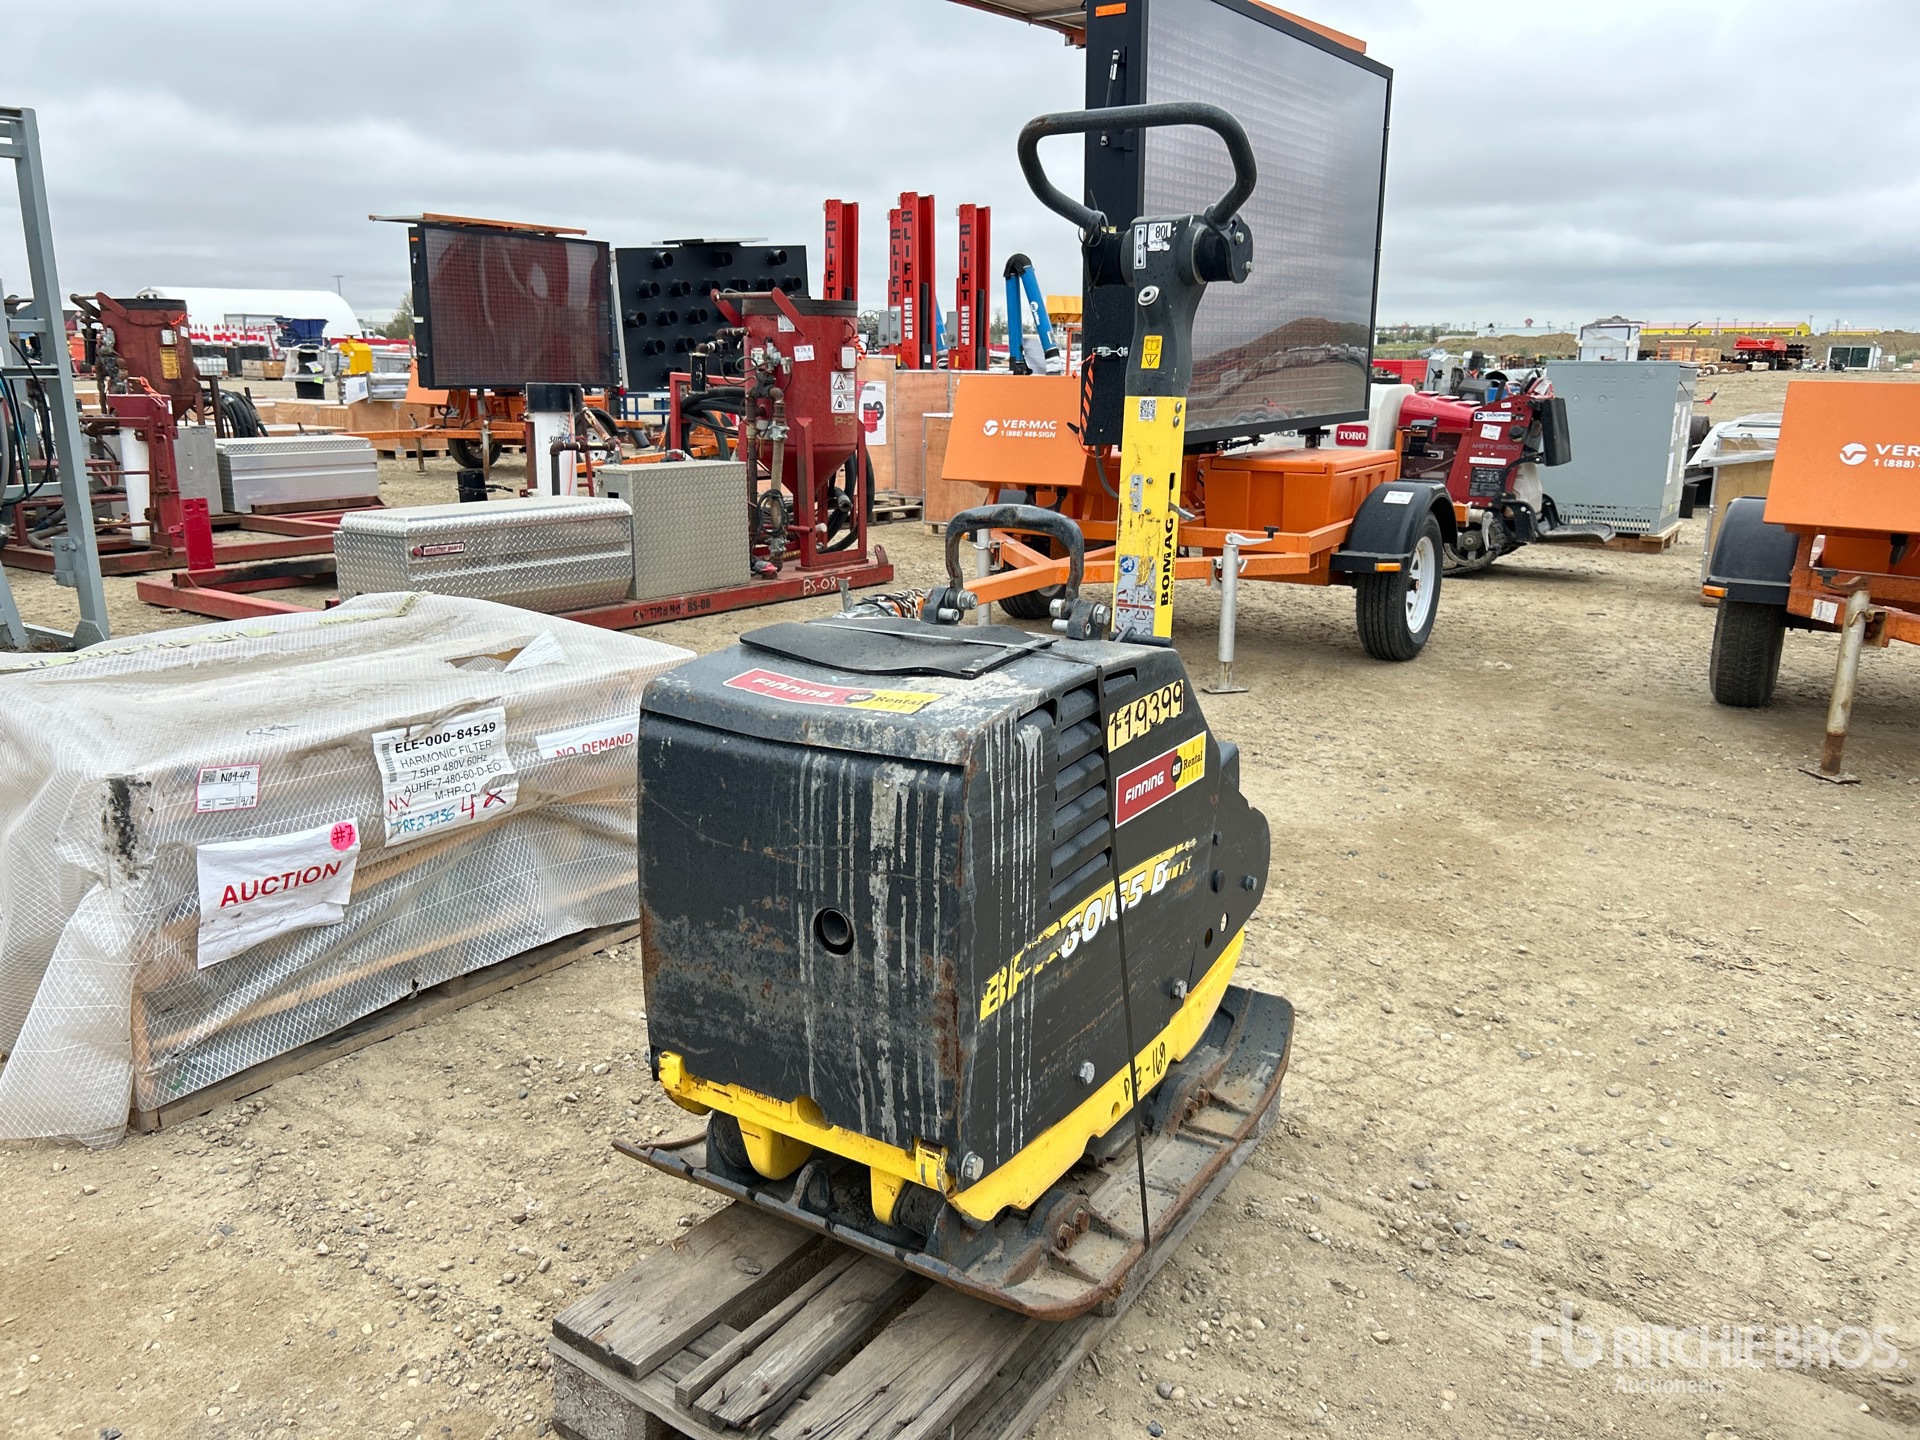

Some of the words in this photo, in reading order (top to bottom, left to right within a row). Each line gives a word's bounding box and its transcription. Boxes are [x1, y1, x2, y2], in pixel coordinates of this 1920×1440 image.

[827, 237, 835, 299] LIFT
[903, 228, 912, 292] LIFT
[961, 240, 969, 301] LIFT
[1002, 419, 1057, 429] VER-MAC
[1339, 431, 1366, 440] TORO
[1873, 458, 1879, 467] 1
[1883, 458, 1915, 469] (888)
[1160, 518, 1174, 606] BOMAG
[751, 677, 835, 698] FINNING
[873, 696, 924, 706] Rental
[395, 722, 496, 754] ELE-000-84549
[582, 732, 633, 754] DEMAND
[400, 746, 457, 769] HARMONIC
[459, 739, 492, 755] FILTER
[411, 765, 441, 780] 7.5HP
[442, 759, 465, 773] 480V
[467, 753, 488, 767] 60Hz
[434, 782, 477, 801] M-HP-C1
[1124, 770, 1165, 804] FINNING
[1183, 750, 1203, 770] Rental
[461, 794, 475, 819] 4
[332, 824, 354, 844] #7
[220, 860, 342, 908] AUCTION
